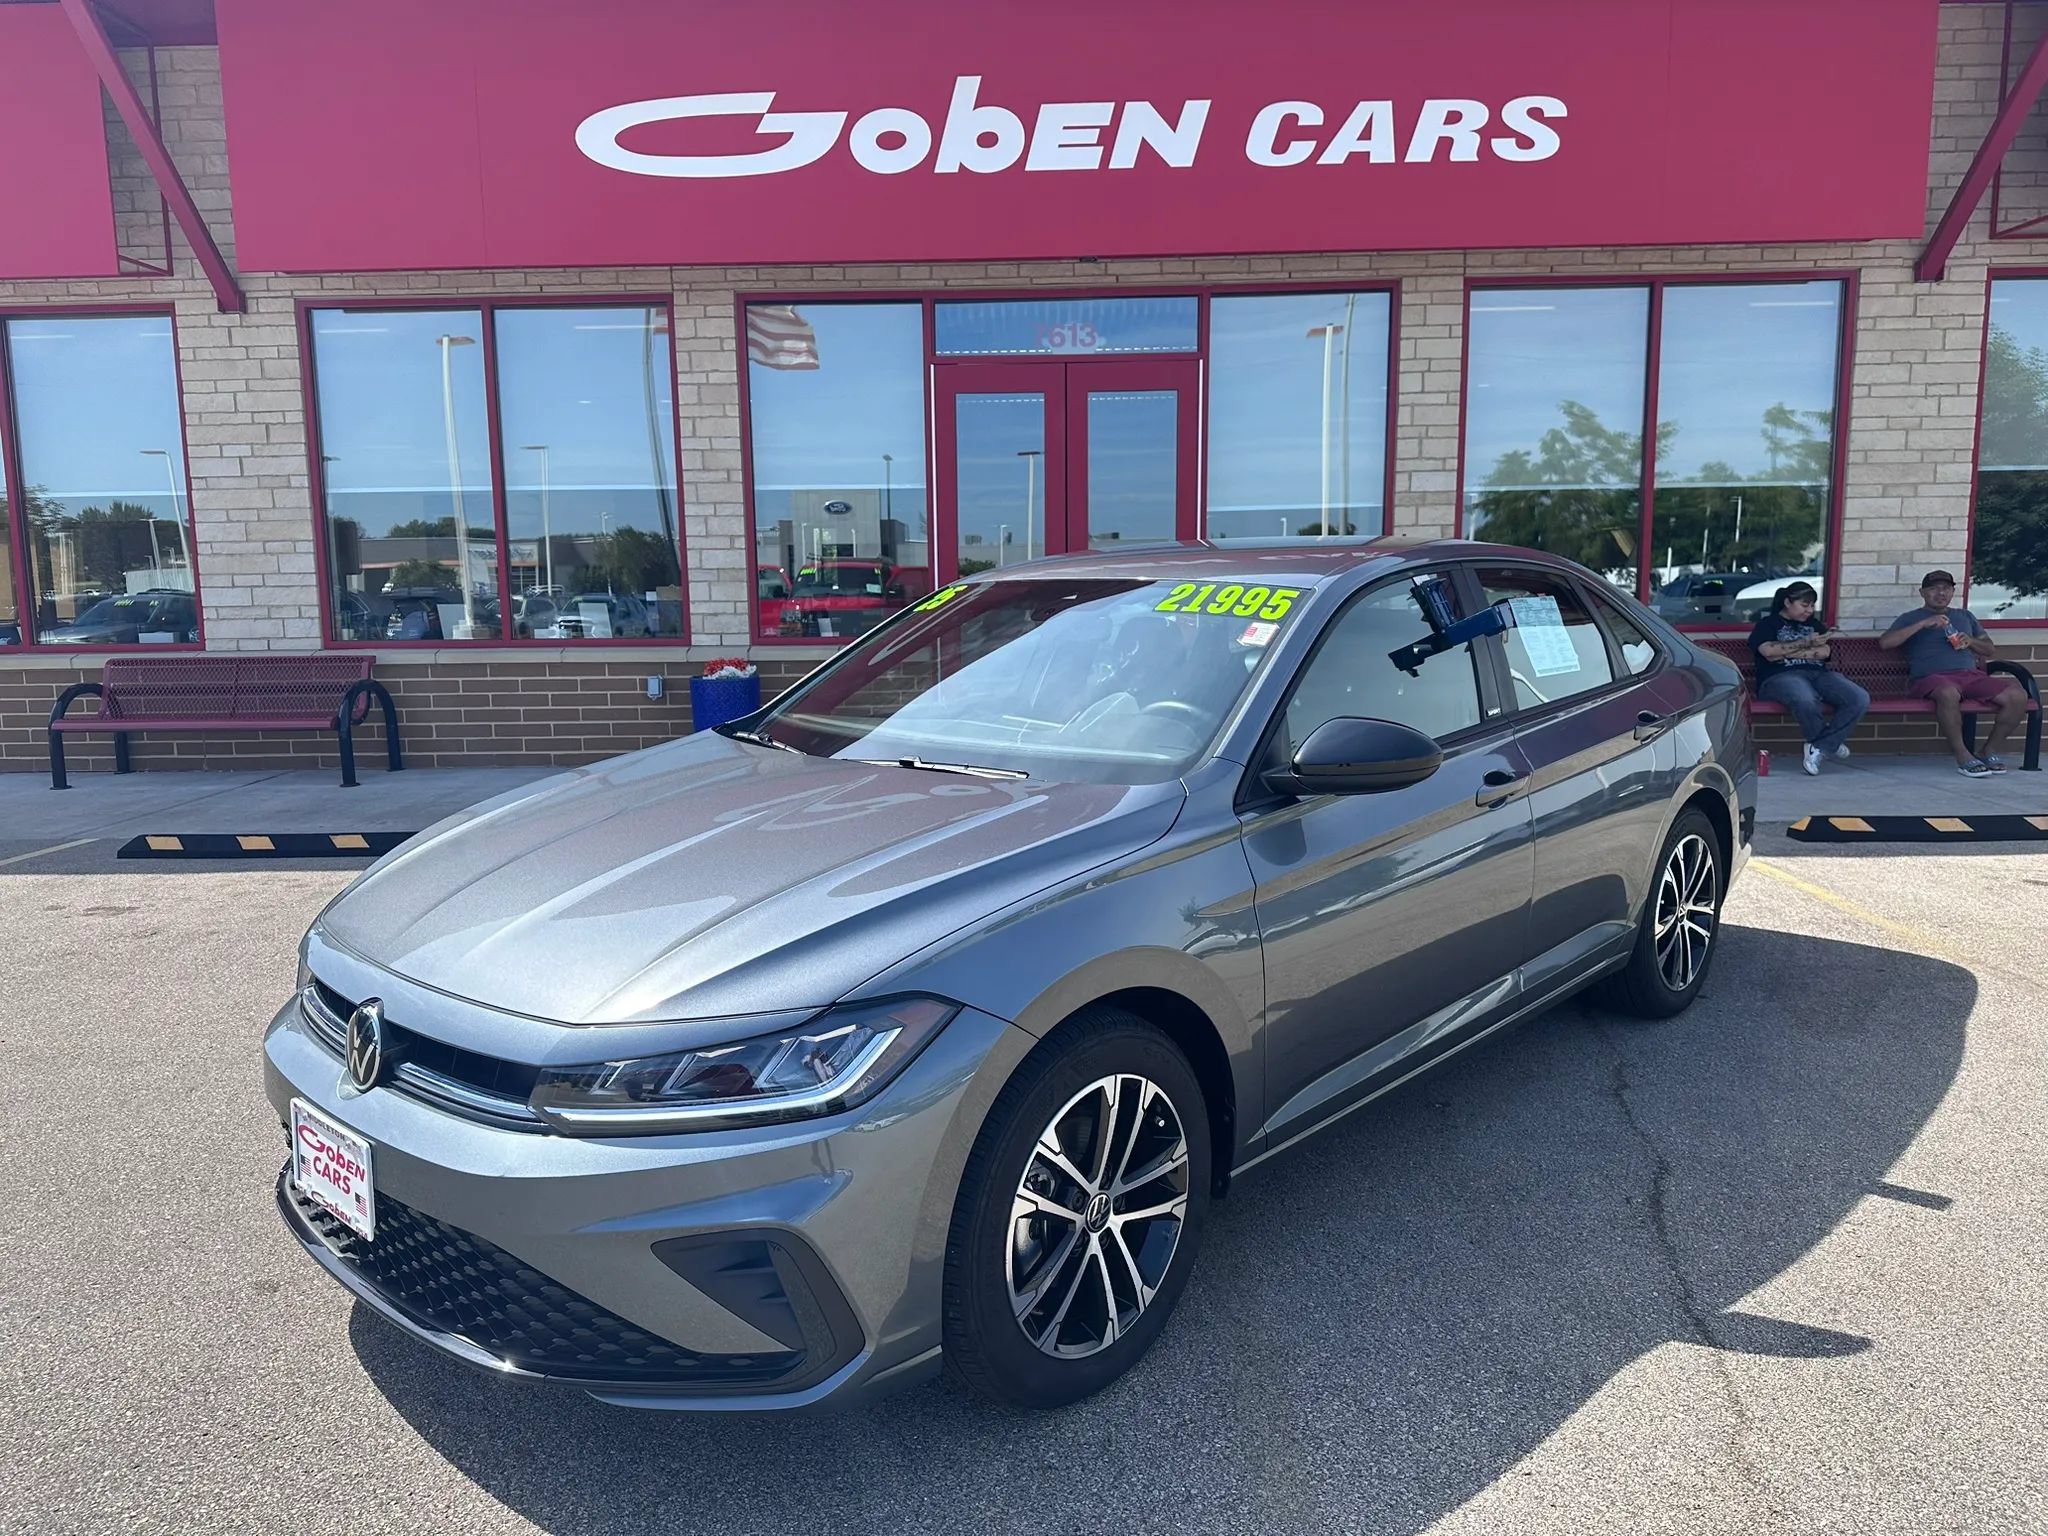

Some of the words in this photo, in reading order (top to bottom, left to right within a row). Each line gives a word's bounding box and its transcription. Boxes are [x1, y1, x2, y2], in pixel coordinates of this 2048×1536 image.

[1246, 95, 1569, 168] CARS
[1154, 583, 1301, 620] 21995
[313, 1156, 351, 1195] CARS
